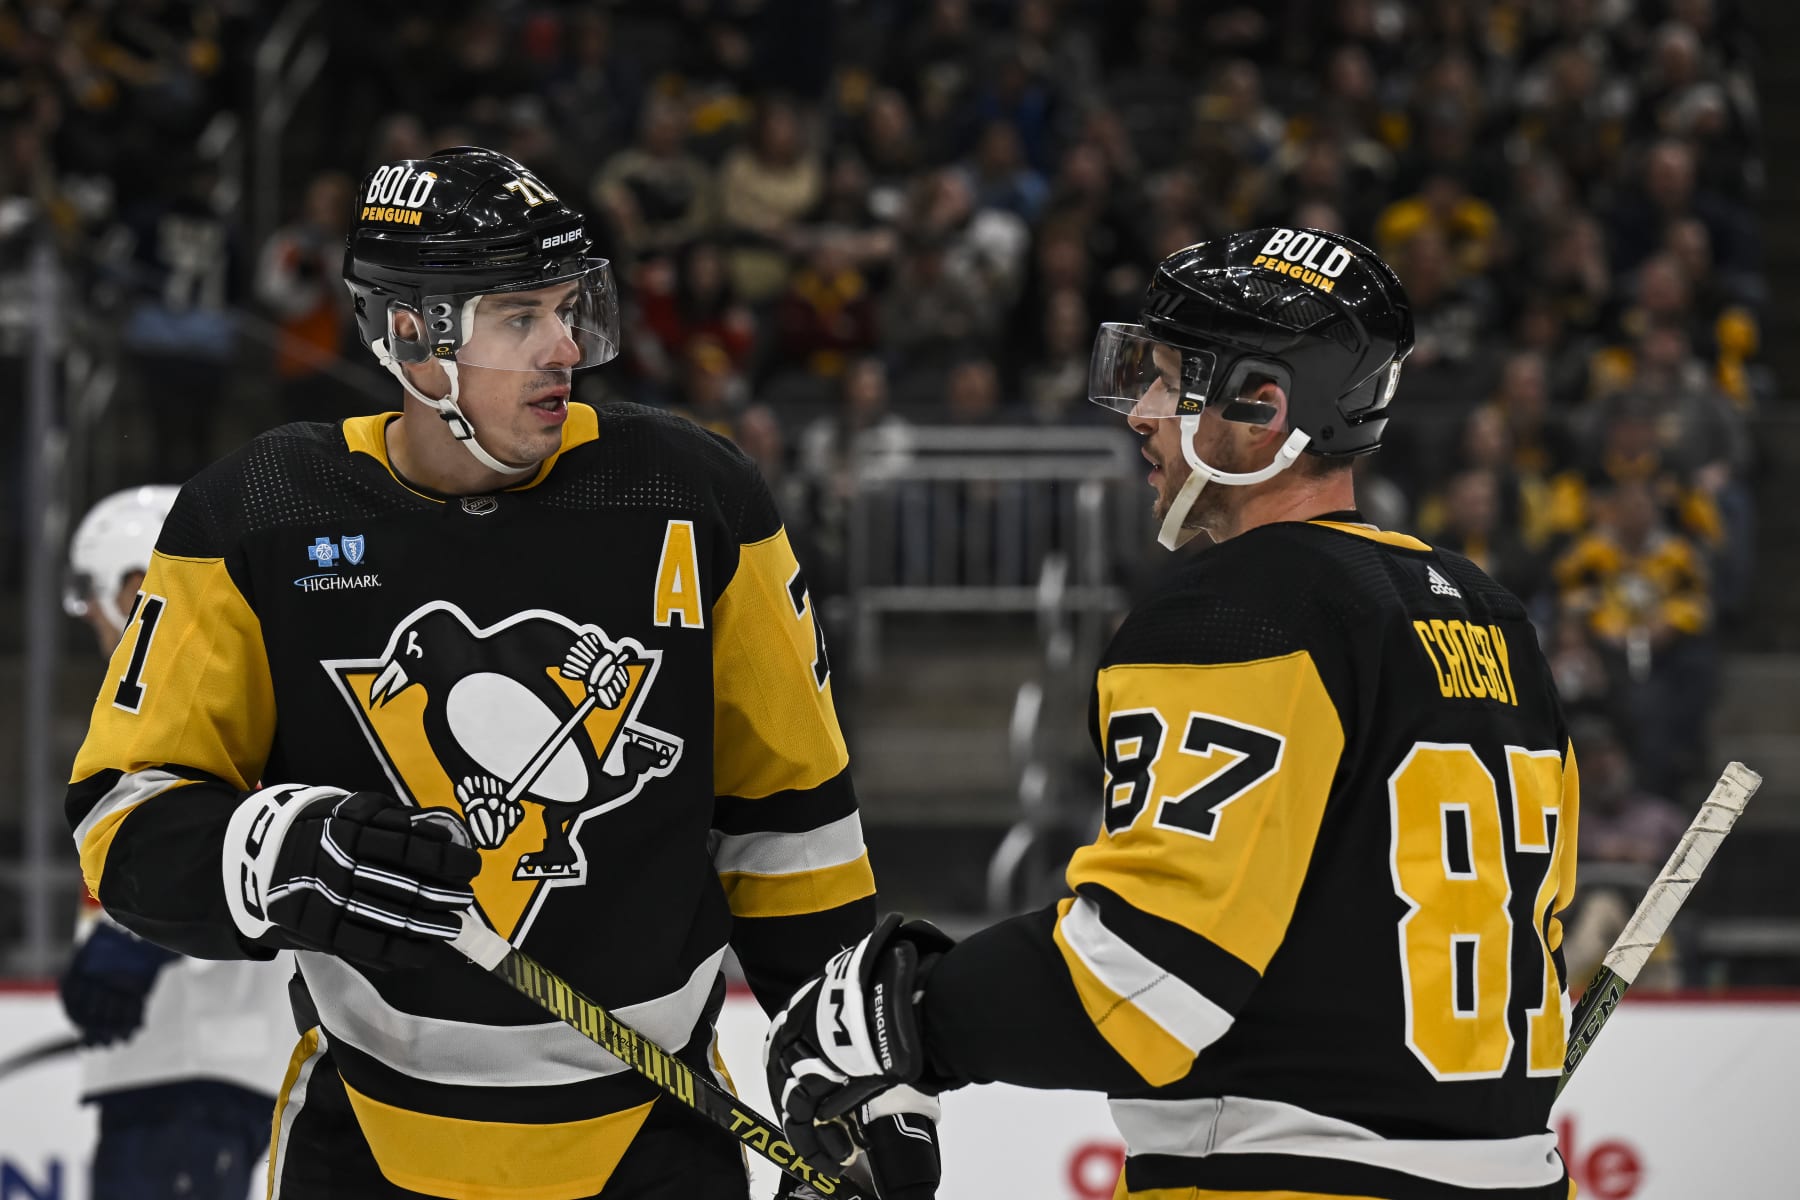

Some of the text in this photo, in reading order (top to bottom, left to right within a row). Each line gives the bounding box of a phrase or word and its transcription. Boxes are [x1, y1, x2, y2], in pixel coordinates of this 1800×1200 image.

[361, 206, 422, 226] PENGUIN
[366, 165, 435, 208] BOLD
[1252, 254, 1336, 294] PENGUIN
[1260, 228, 1351, 278] BOLD
[302, 574, 380, 593] HIGHMARK
[654, 520, 704, 629] A
[1413, 619, 1518, 706] CROSBY
[1102, 706, 1286, 843] 87
[1387, 741, 1566, 1082] 87
[874, 983, 893, 1071] PENGUINS
[1563, 984, 1620, 1075] CCM
[728, 1108, 841, 1195] TACKS
